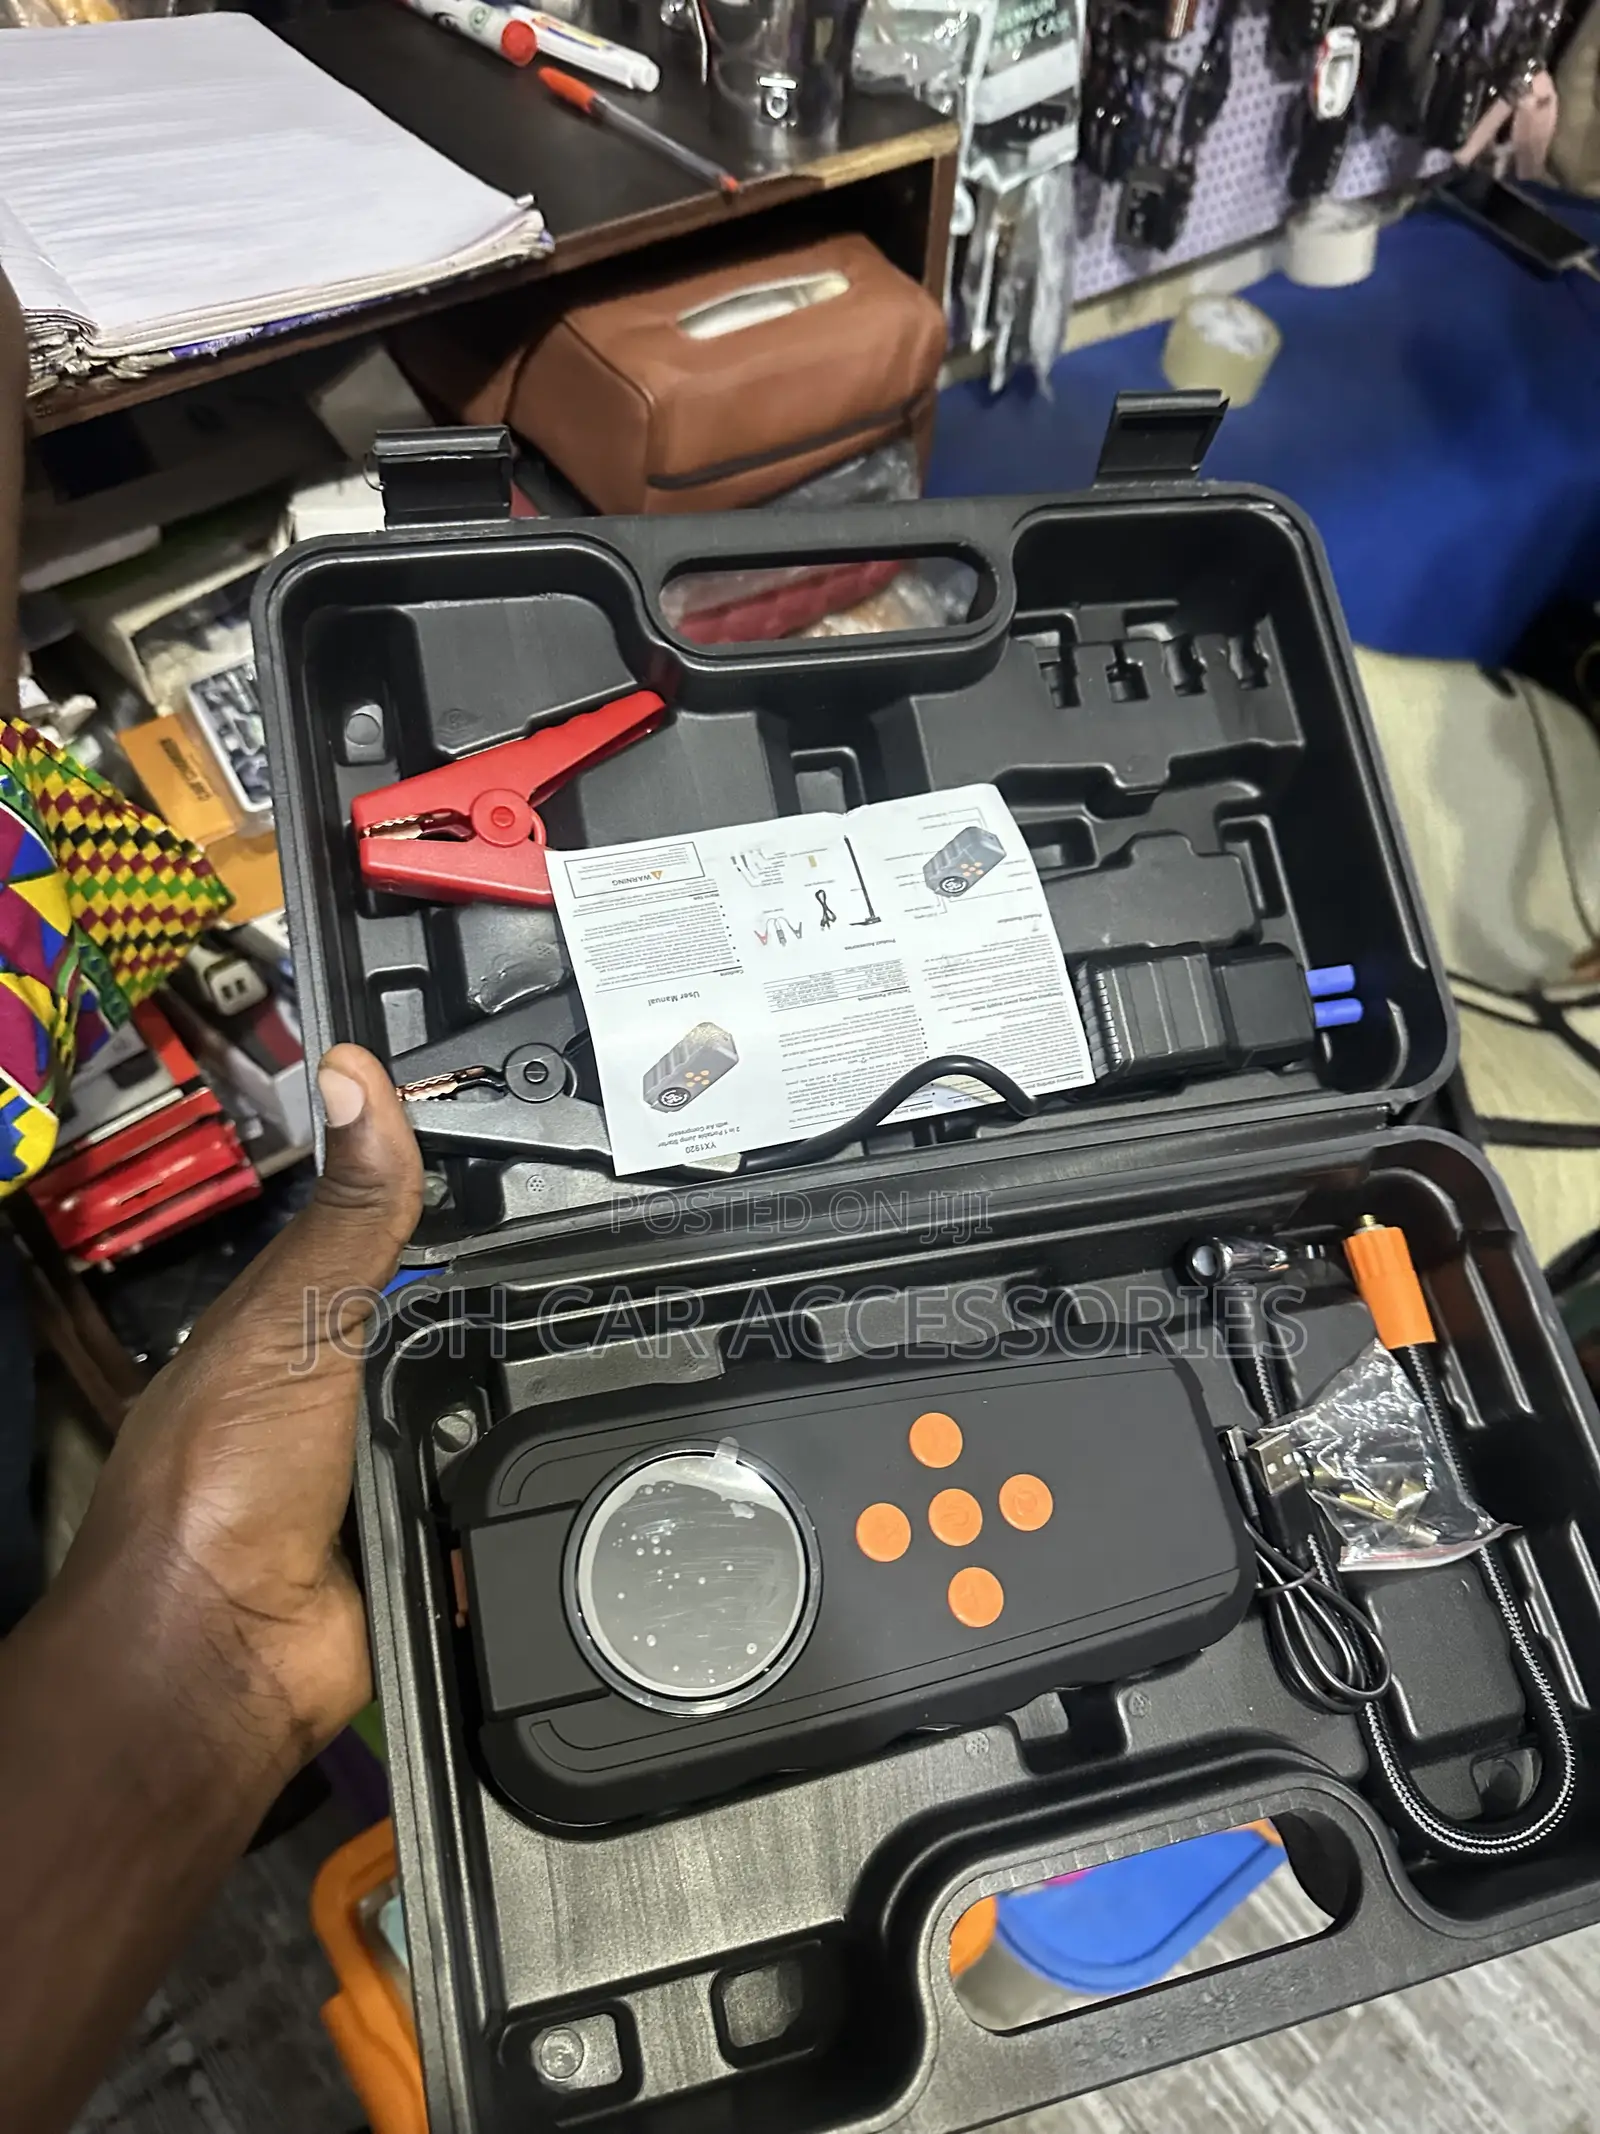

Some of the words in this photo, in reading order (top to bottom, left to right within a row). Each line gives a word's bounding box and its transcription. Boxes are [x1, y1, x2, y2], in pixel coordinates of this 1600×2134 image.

[611, 873, 652, 886] WARNING
[647, 994, 679, 1007] Manual
[680, 990, 700, 1000] User
[667, 1125, 705, 1138] Compressor
[705, 1123, 715, 1131] Air
[679, 1134, 697, 1143] Jump
[698, 1129, 723, 1140] Portable
[657, 1138, 679, 1148] Starter
[685, 1141, 717, 1154] YX1920
